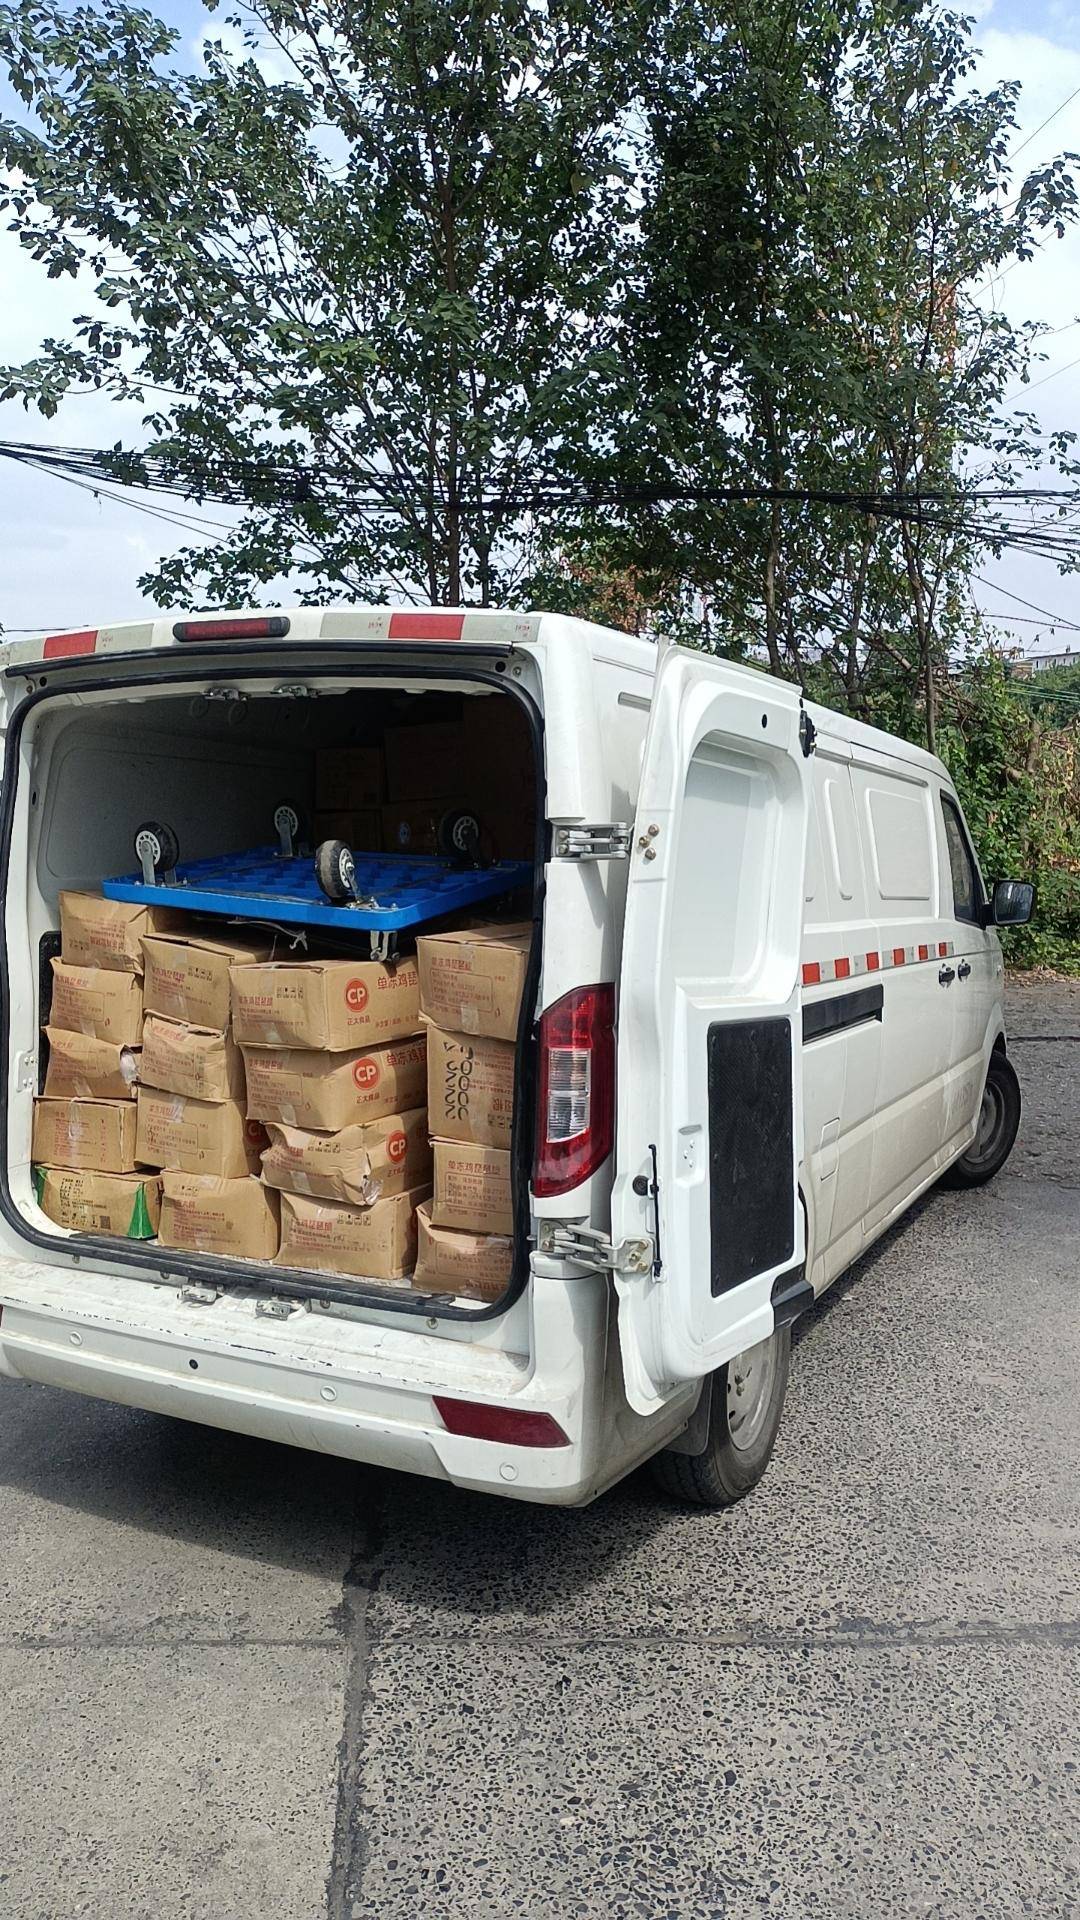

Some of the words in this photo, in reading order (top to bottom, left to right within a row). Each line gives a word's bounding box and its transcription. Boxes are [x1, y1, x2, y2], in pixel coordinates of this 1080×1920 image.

[346, 988, 366, 1004] CP
[355, 1065, 377, 1082] CP
[390, 1138, 406, 1156] CP
